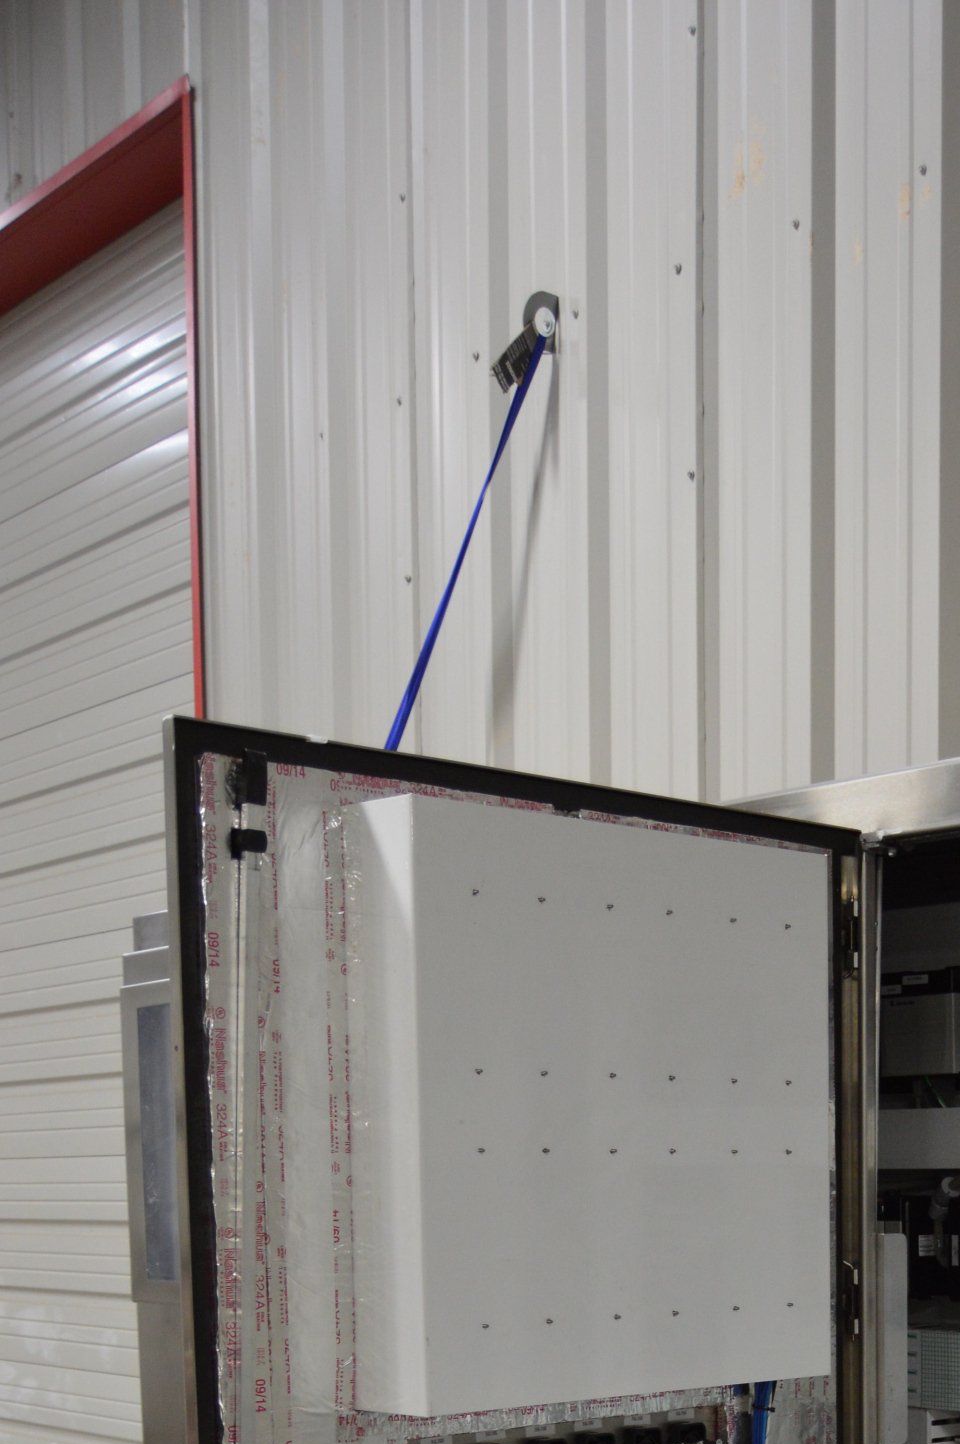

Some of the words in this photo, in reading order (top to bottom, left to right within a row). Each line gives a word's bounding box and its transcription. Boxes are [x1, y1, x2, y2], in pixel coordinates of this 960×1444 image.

[276, 762, 306, 779] 09/14
[205, 824, 218, 861] 324A
[207, 932, 220, 968] 09/14
[216, 1103, 229, 1140] 324A
[255, 1274, 265, 1310] 324A
[255, 1379, 267, 1413] 09/14
